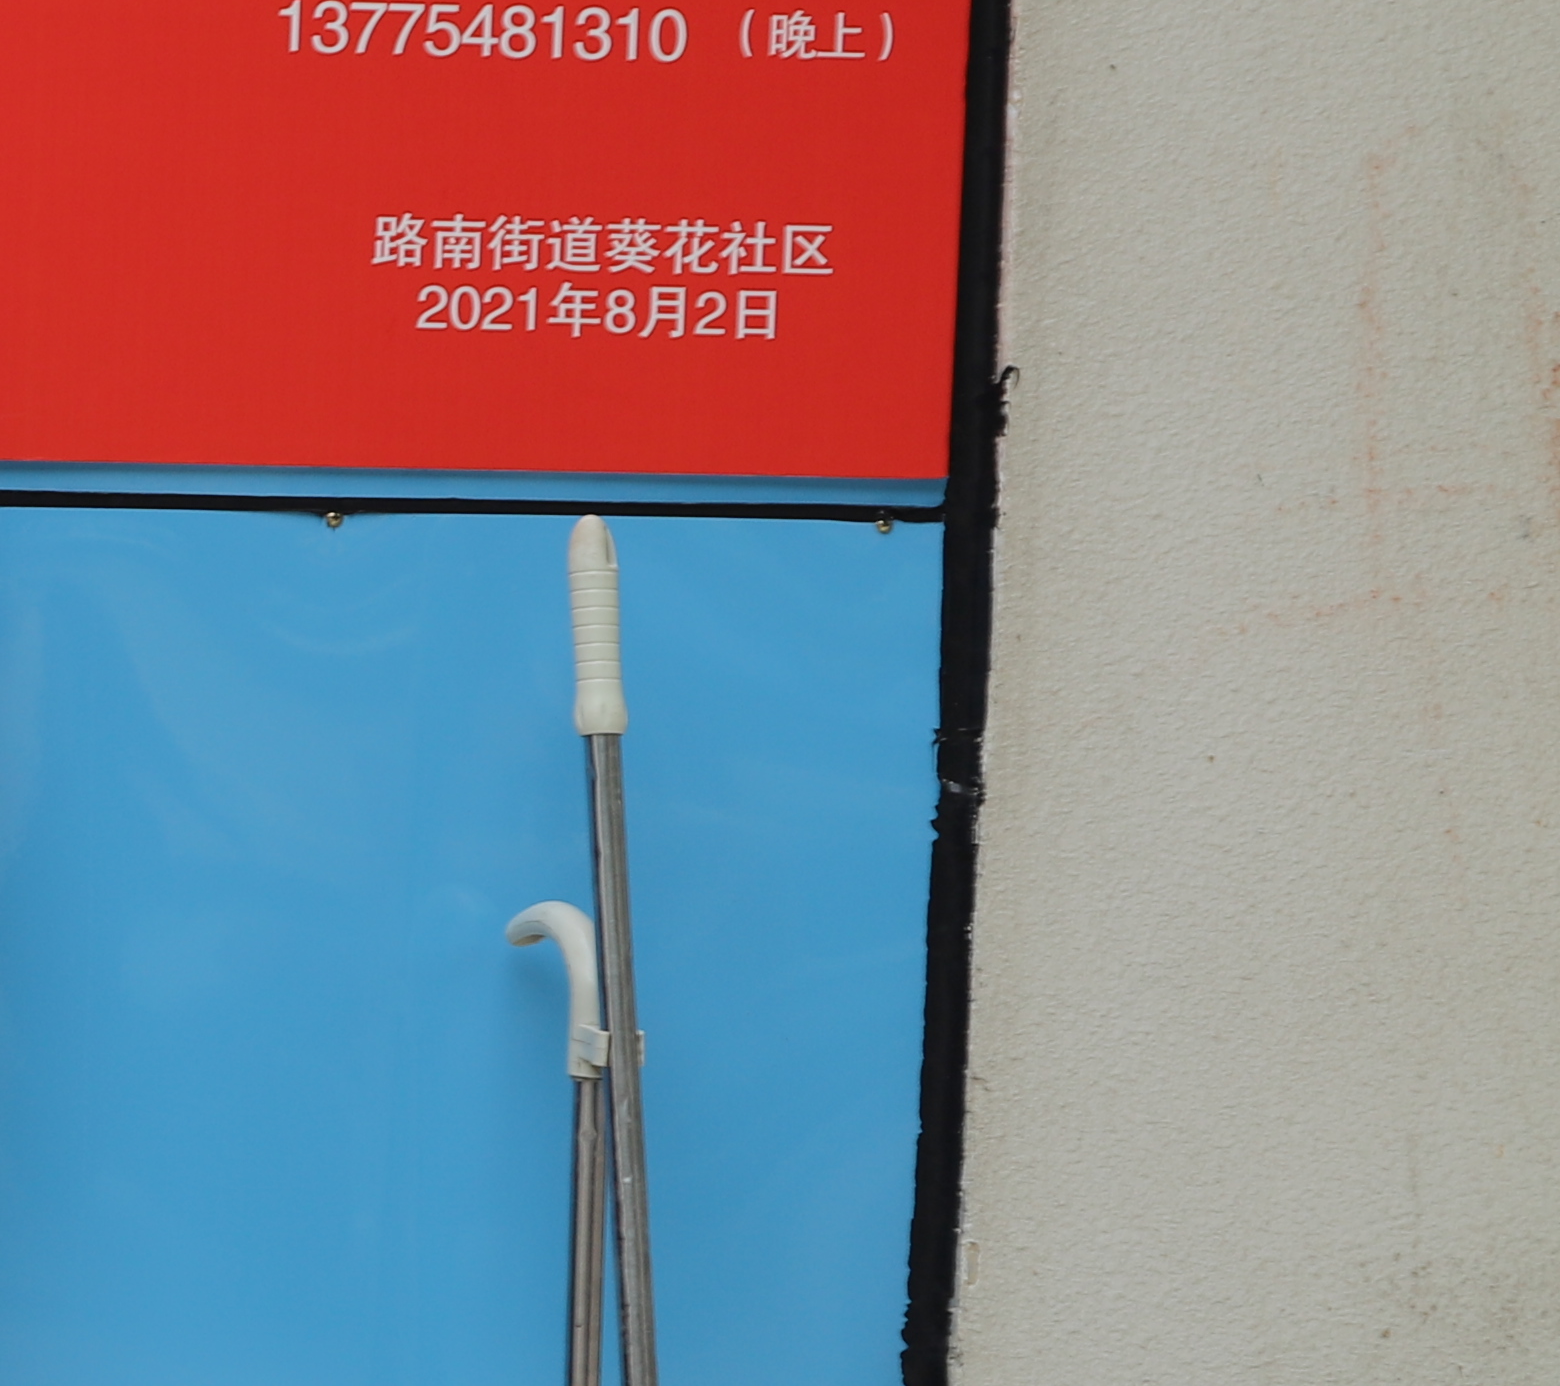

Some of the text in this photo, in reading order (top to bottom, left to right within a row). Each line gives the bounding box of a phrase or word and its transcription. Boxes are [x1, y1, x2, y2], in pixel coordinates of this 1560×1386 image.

[371, 213, 835, 277] 路南街道葵花社区
[415, 282, 780, 341] 2021年8月2日
